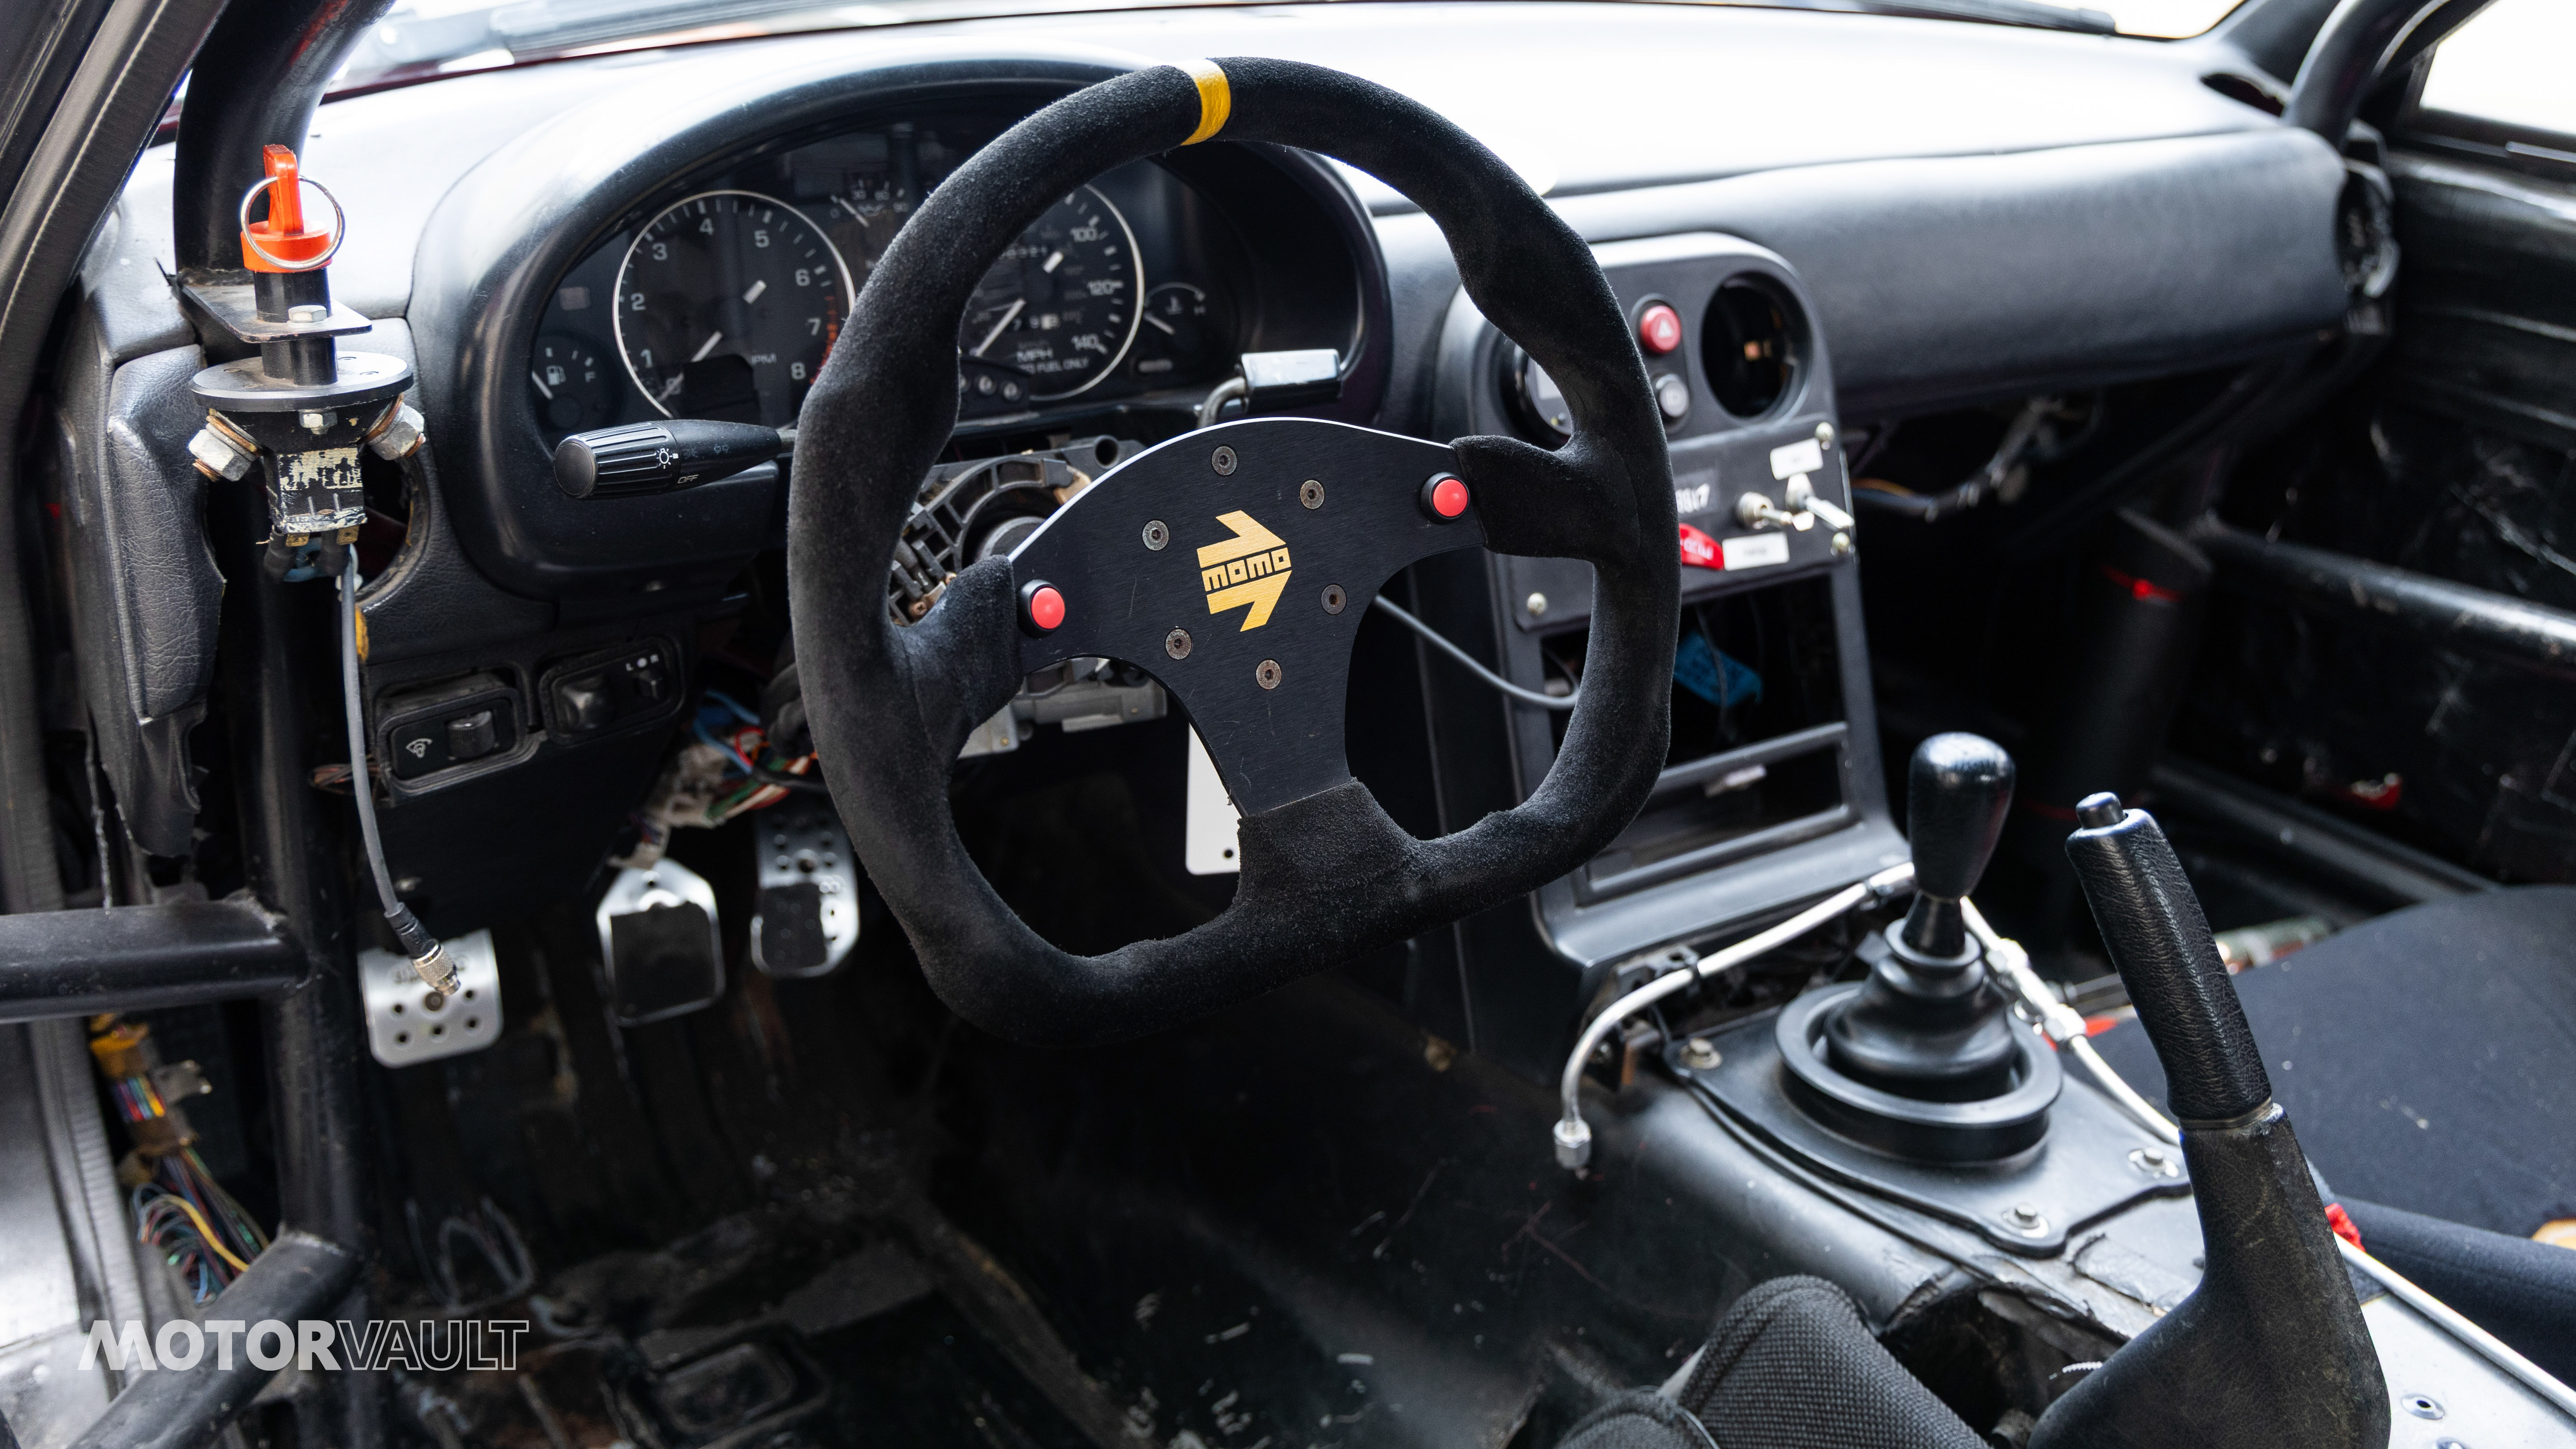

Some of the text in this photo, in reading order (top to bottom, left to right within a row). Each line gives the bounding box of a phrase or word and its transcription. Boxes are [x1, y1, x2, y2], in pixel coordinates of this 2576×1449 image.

[699, 218, 714, 236] 4
[1070, 227, 1098, 242] 100
[754, 229, 770, 247] 5
[652, 242, 668, 261] 3
[795, 268, 811, 287] 6
[1087, 280, 1115, 296] 120
[630, 293, 647, 311] 2
[808, 317, 821, 336] 7
[1072, 334, 1099, 350] 140
[641, 349, 653, 368] 1
[1016, 348, 1053, 363] MPH
[585, 371, 596, 383] F
[790, 361, 807, 381] 8
[677, 474, 699, 484] OFF
[626, 654, 659, 671] L R
